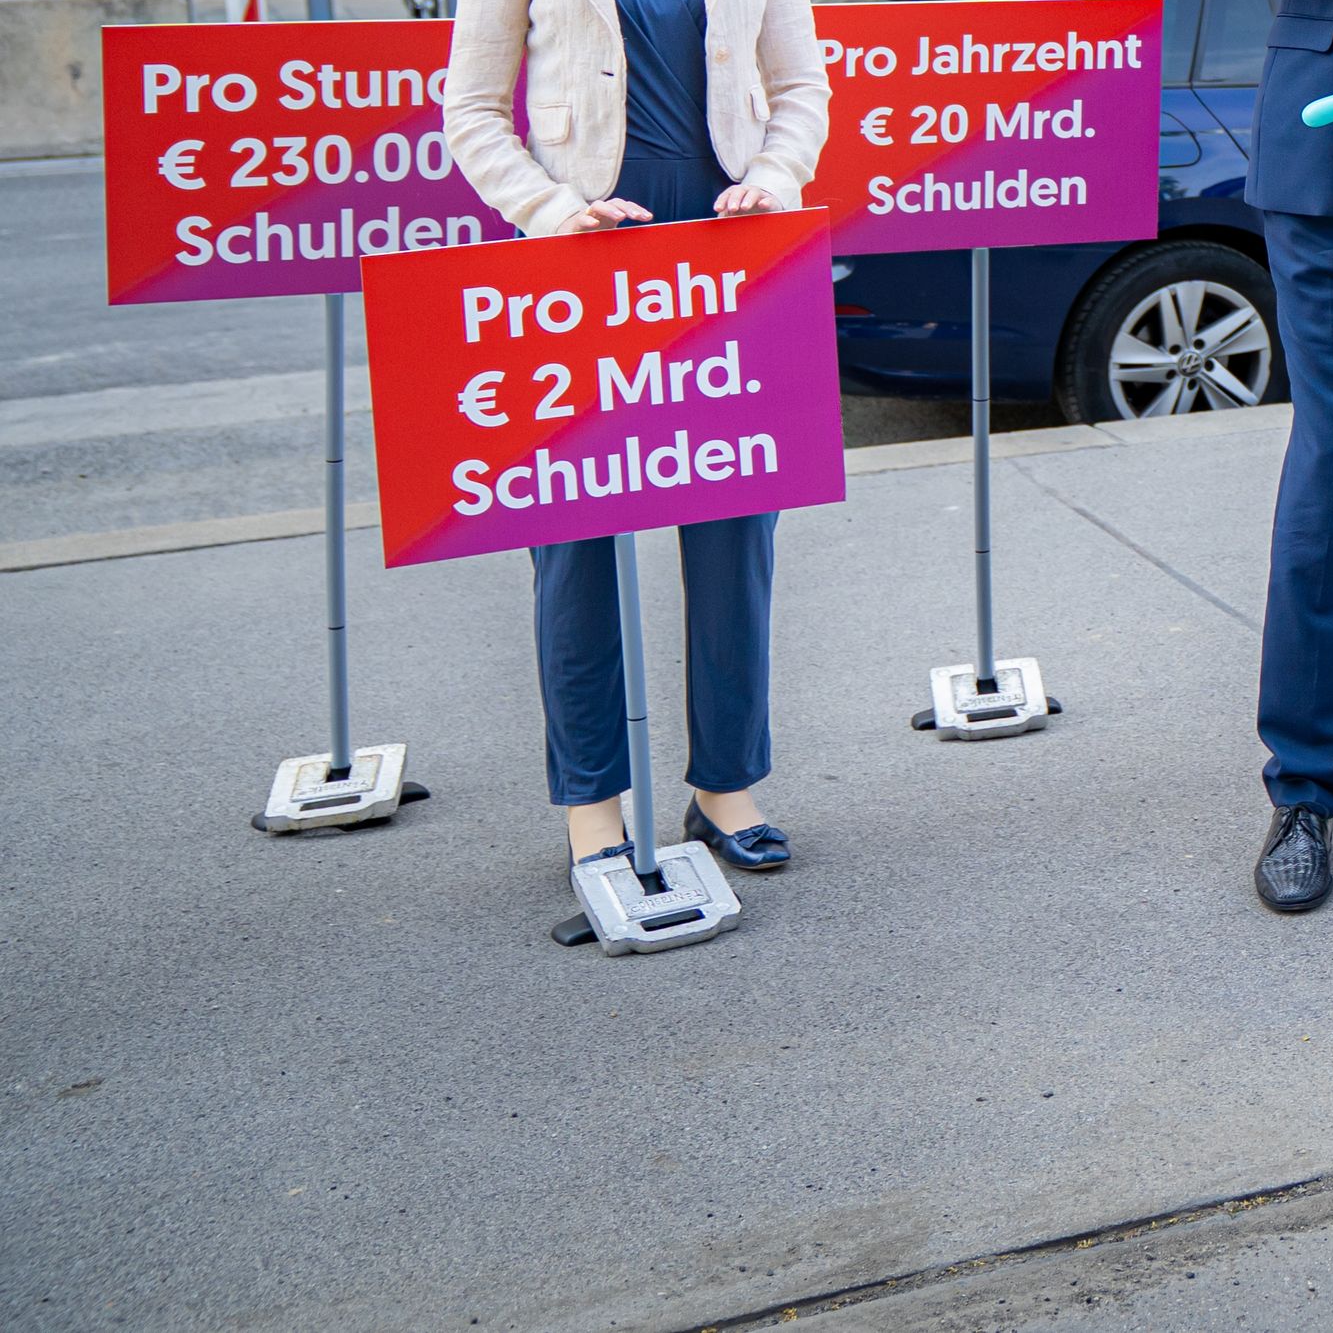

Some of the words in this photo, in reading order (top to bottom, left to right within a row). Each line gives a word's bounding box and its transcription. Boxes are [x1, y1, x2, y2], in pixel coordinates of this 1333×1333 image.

[818, 40, 896, 77] Pro
[912, 31, 1142, 76] Jahrzehnt
[143, 63, 257, 114] Pro
[860, 107, 893, 146] €
[910, 104, 968, 144] 20
[985, 100, 1095, 142] Mrd.
[159, 140, 205, 190] €
[231, 131, 453, 187] 230.00
[868, 169, 1087, 215] Schulden
[176, 206, 482, 266] Schulden
[462, 286, 583, 343] Pro
[604, 261, 746, 328] Jahr
[458, 371, 508, 427] €
[532, 364, 575, 421] 2
[598, 340, 763, 413] Mrd.
[452, 429, 779, 516] Schulden
